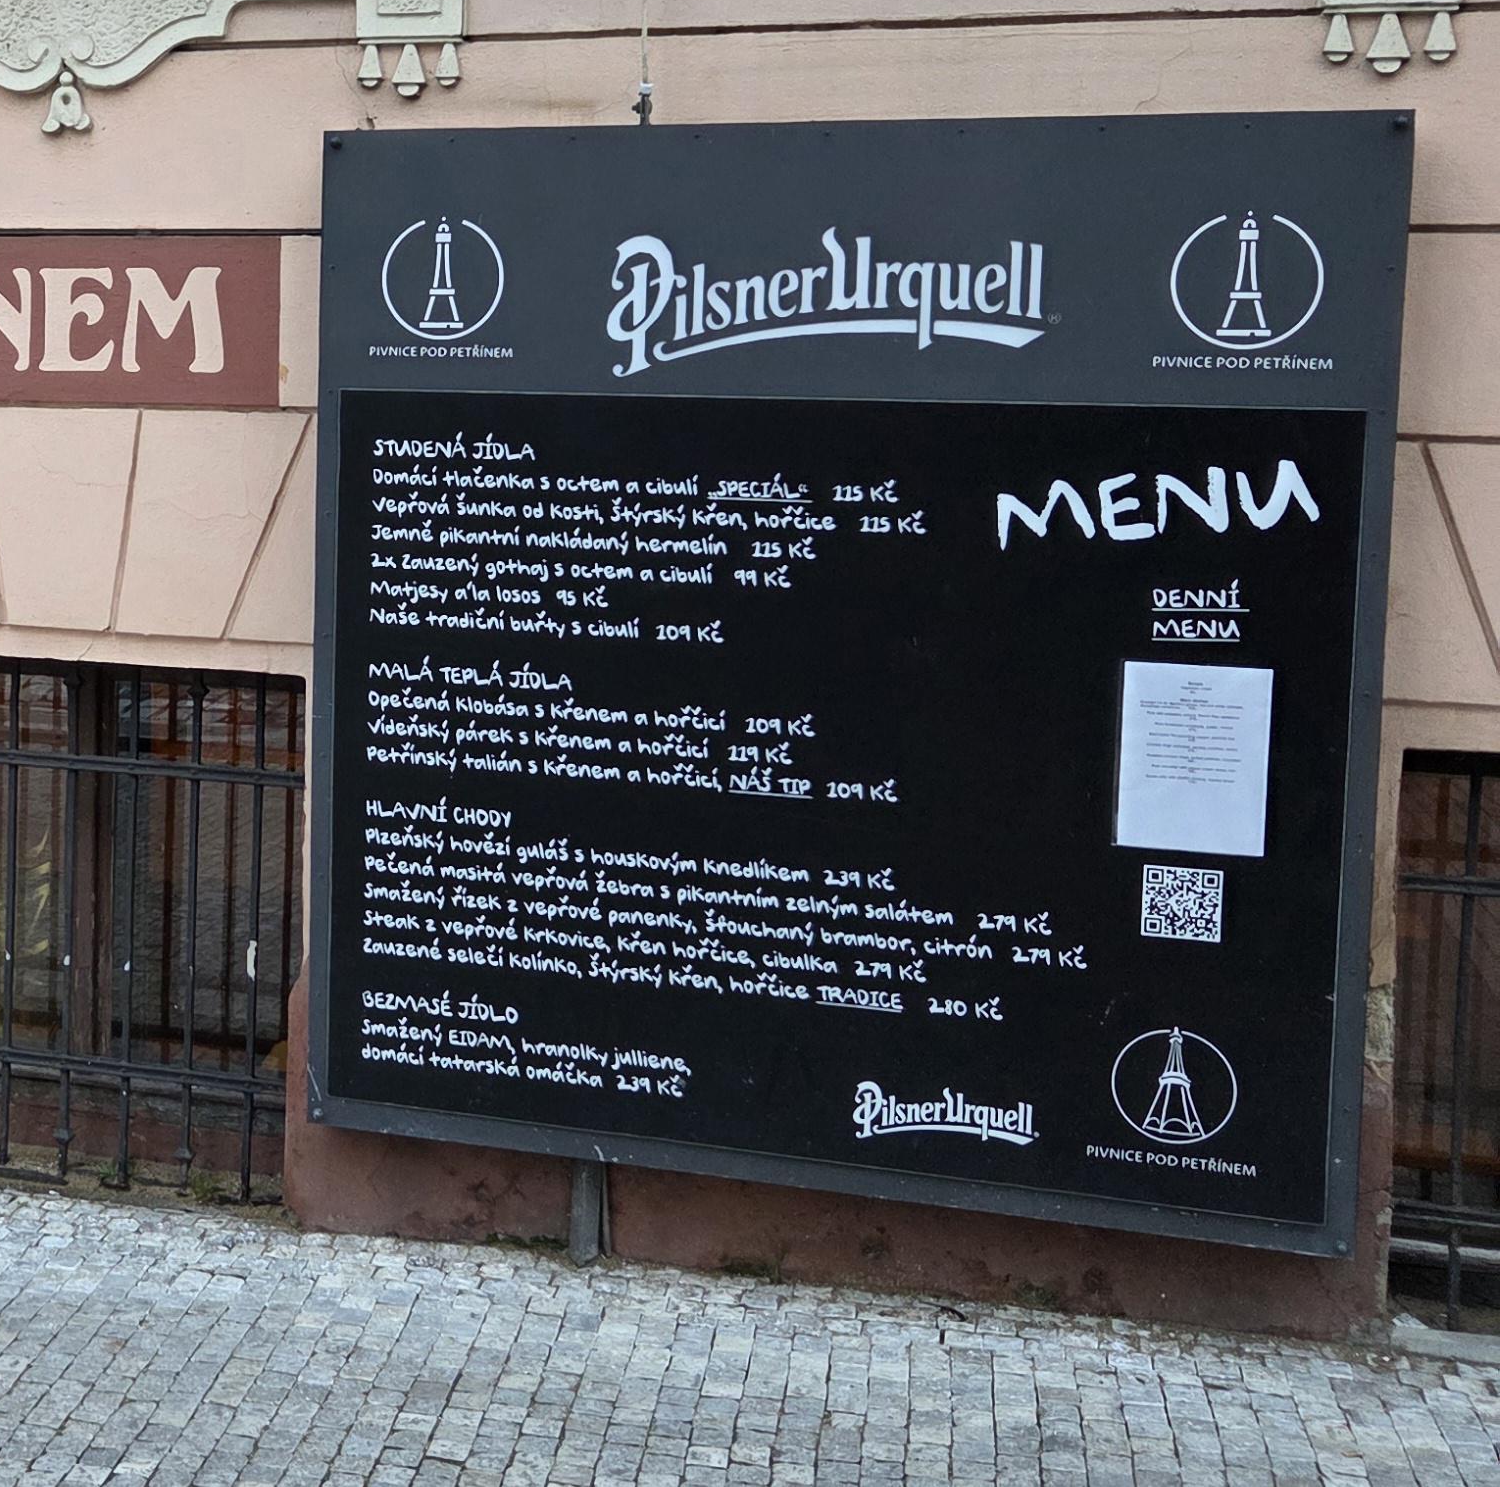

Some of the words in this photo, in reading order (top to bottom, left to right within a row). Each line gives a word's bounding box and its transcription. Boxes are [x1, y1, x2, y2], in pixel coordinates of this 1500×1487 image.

[369, 345, 417, 357] PIVNICE
[420, 346, 447, 357] POD
[449, 341, 514, 359] PETŘÍNEM
[1152, 355, 1213, 370] PIVNICE
[1216, 356, 1250, 370] POD
[1253, 353, 1334, 371] PETŘÍNEM
[373, 432, 466, 458] STUDENÁ
[472, 433, 535, 460] JÍDLA
[373, 464, 437, 486] Domácí
[443, 466, 534, 489] tlačenka
[557, 476, 619, 492] octem
[646, 475, 698, 495] cibulí
[833, 485, 863, 501] 115
[870, 480, 898, 502] Kč
[372, 491, 450, 518] Vepřová
[456, 492, 516, 517] šunka
[523, 502, 543, 518] od
[550, 503, 604, 525] kosti,
[693, 503, 747, 530] křen,
[755, 506, 836, 530] hořčice
[860, 516, 890, 532] 115
[898, 510, 926, 534] Kč
[997, 460, 1319, 550] MENU
[371, 519, 433, 542] Jemně
[440, 526, 519, 547] pikantní
[526, 527, 628, 555] nakládaný
[635, 534, 727, 555] hermelín
[752, 541, 782, 557] 115
[789, 537, 816, 559] Kč
[485, 559, 549, 582] gothaj
[571, 563, 633, 579] octem
[660, 563, 712, 584] cibulí
[734, 570, 757, 586] 99
[764, 565, 791, 588] Kč
[1152, 578, 1240, 609] DENNÍ
[371, 581, 448, 603] Matjesy
[496, 585, 540, 604] losos
[556, 590, 576, 606] 95
[583, 585, 608, 607] Kč
[370, 602, 420, 625] Naše
[425, 607, 504, 630] tradiční
[510, 610, 565, 638] buřty
[588, 617, 639, 638] cibulí
[656, 625, 690, 641] 109
[698, 620, 724, 643] Kč
[1152, 618, 1240, 639] MENU
[369, 655, 433, 681] MALÁ
[439, 660, 503, 687] TEPLÁ
[509, 662, 572, 691] JÍDLA
[368, 687, 450, 711] Opečená
[456, 694, 529, 716] klobása
[551, 697, 627, 723] křenem
[654, 705, 725, 730] hořčicí
[746, 718, 781, 734] 109
[788, 714, 815, 737] Kč
[367, 714, 449, 744] Vídeňský
[456, 720, 513, 745] párek
[535, 725, 611, 750] křenem
[637, 733, 708, 758] hořčicí
[728, 745, 758, 762] 119
[766, 742, 792, 764] Kč
[367, 742, 457, 772] Petřínský
[463, 750, 522, 772] talián
[544, 754, 620, 779] křenem
[647, 763, 722, 792] hořčicí,
[729, 766, 772, 793] NÁŠ
[781, 777, 812, 795] TIP
[827, 782, 863, 799] 109
[870, 779, 897, 802] Kč
[366, 796, 447, 822] HLAVNÍ
[453, 807, 511, 828] CHODY
[365, 825, 444, 854] Plzeňský
[450, 832, 510, 856] hovězí
[517, 838, 568, 863] guláš
[591, 848, 696, 876] houskovým
[704, 858, 809, 882] knedlíkem
[823, 870, 860, 887] 239
[868, 868, 895, 891] Kč
[365, 851, 434, 876] Pečená
[440, 862, 506, 883] masitá
[511, 866, 588, 891] vepřová
[595, 870, 654, 897] žebra
[677, 885, 779, 908] pikantním
[786, 895, 858, 920] zelným
[865, 899, 953, 925] salátem
[977, 913, 1016, 932] 279
[1024, 912, 1052, 935] Kč
[364, 880, 445, 910] Smažený
[451, 885, 501, 910] řízek
[524, 895, 602, 921] vepřové
[609, 910, 697, 934] panenky,
[821, 928, 916, 955] brambor,
[924, 934, 992, 959] citrón
[1012, 947, 1050, 965] 279
[1059, 945, 1087, 969] Kč
[364, 910, 420, 929] Steak
[441, 915, 518, 940] vepřové
[524, 926, 611, 953] krkovice,
[618, 931, 666, 954] křen
[672, 938, 755, 968] hořčice,
[763, 951, 837, 973] cibulka
[854, 961, 891, 979] 279
[899, 959, 926, 982] Kč
[363, 937, 442, 960] Zauzené
[510, 951, 582, 979] kolínko,
[669, 964, 723, 994] křen,
[729, 972, 809, 999] hořčice
[818, 985, 904, 1011] TRADICE
[928, 998, 967, 1016] 280
[975, 997, 1003, 1020] Kč
[362, 990, 453, 1017] BEZMASÉ
[458, 994, 518, 1024] JÍDLO
[362, 1017, 442, 1047] Smažený
[449, 1030, 515, 1055] EIDAM,
[522, 1038, 608, 1067] hranolky
[362, 1042, 424, 1065] domácí
[429, 1052, 520, 1077] tatarská
[526, 1061, 602, 1087] omáčka
[617, 1075, 651, 1093] 239
[657, 1075, 684, 1097] Kč
[1086, 1144, 1143, 1164] PIVNICE
[1146, 1151, 1178, 1168] POD
[1181, 1152, 1257, 1177] PETŘÍNEM
